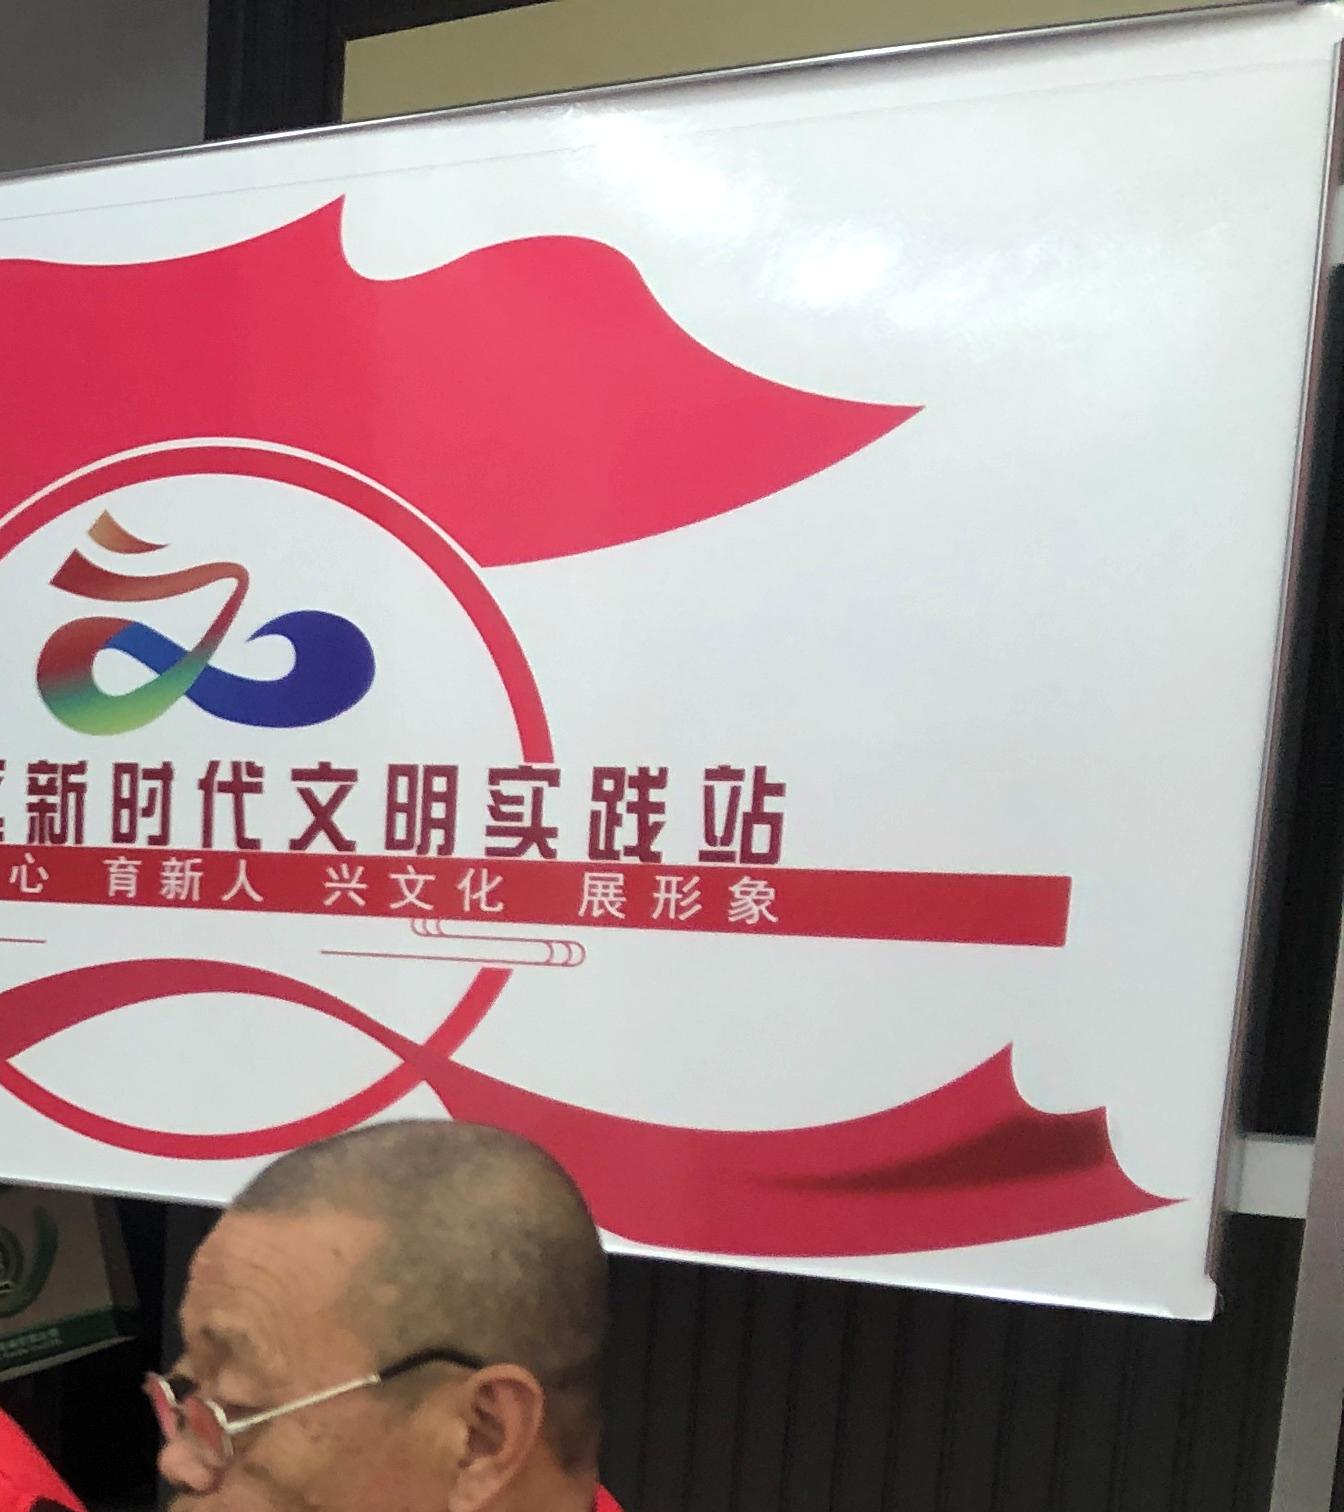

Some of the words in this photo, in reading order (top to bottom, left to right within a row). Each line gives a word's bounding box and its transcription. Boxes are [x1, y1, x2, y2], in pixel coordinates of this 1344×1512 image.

[102, 856, 265, 902] 育新人
[323, 863, 505, 912] 兴文化
[578, 871, 780, 924] 展形象
